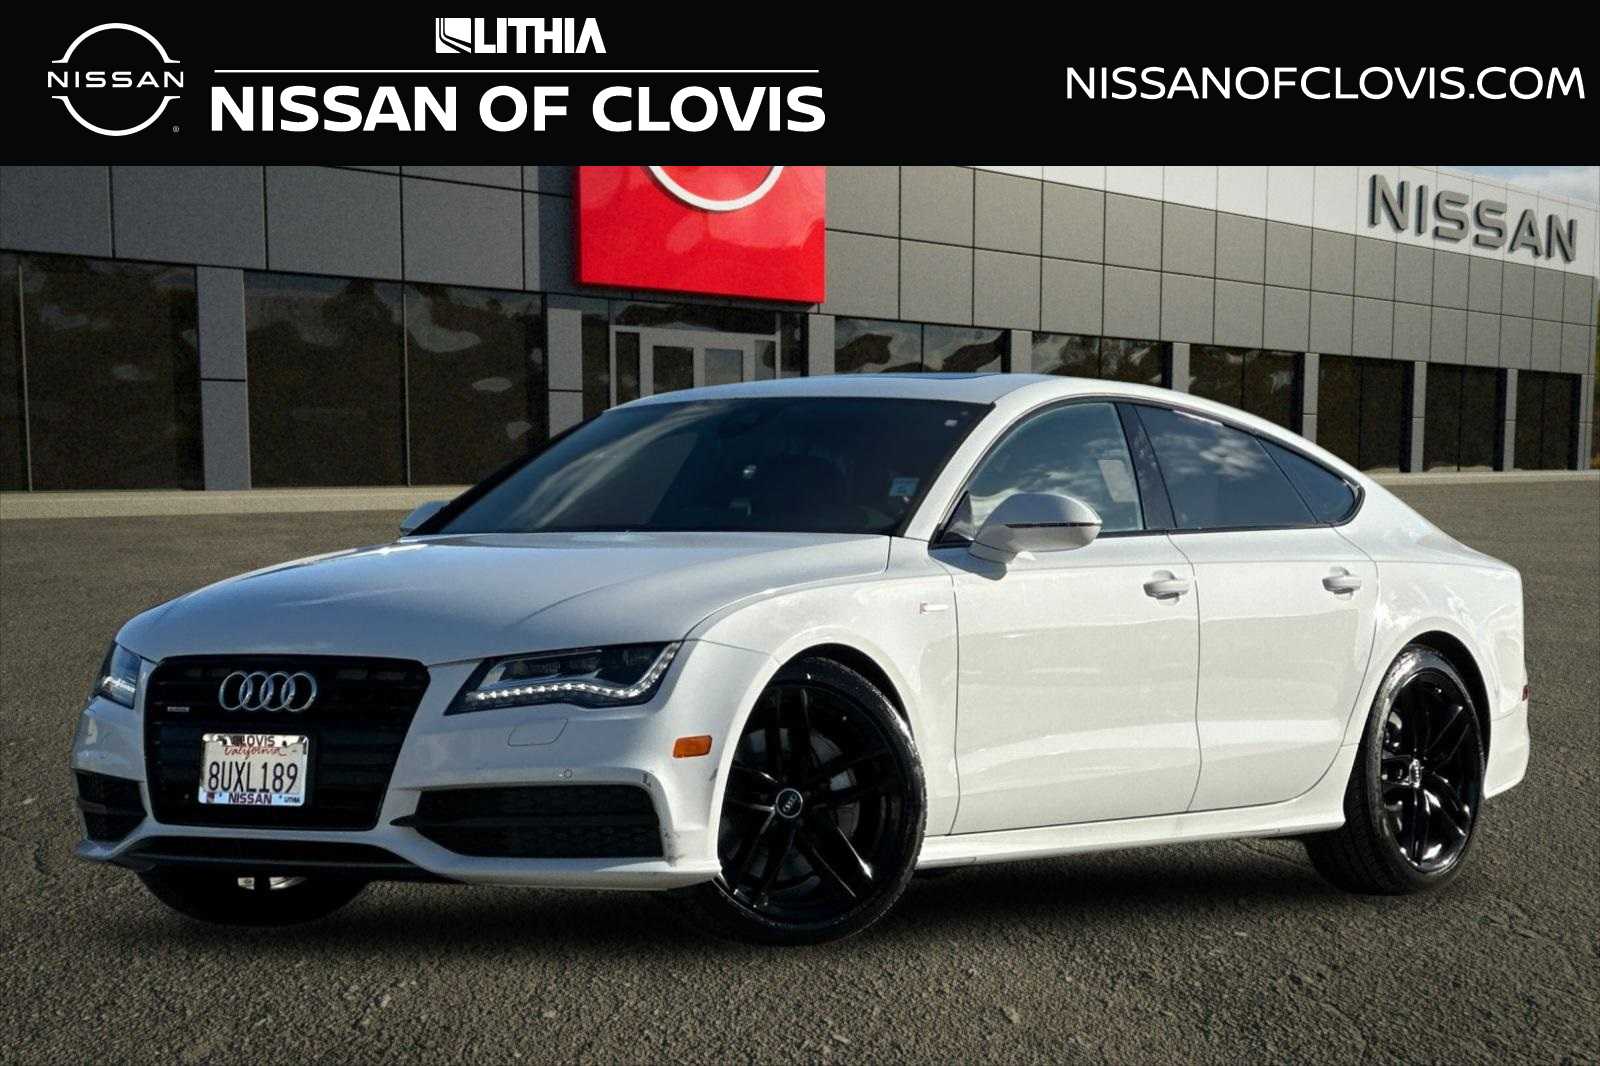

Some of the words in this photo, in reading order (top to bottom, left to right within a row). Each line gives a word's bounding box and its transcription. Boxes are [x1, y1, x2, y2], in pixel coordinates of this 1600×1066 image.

[1368, 174, 1577, 263] NISSAN
[208, 761, 298, 794] 8UXL189
[228, 792, 272, 804] NISSAN
